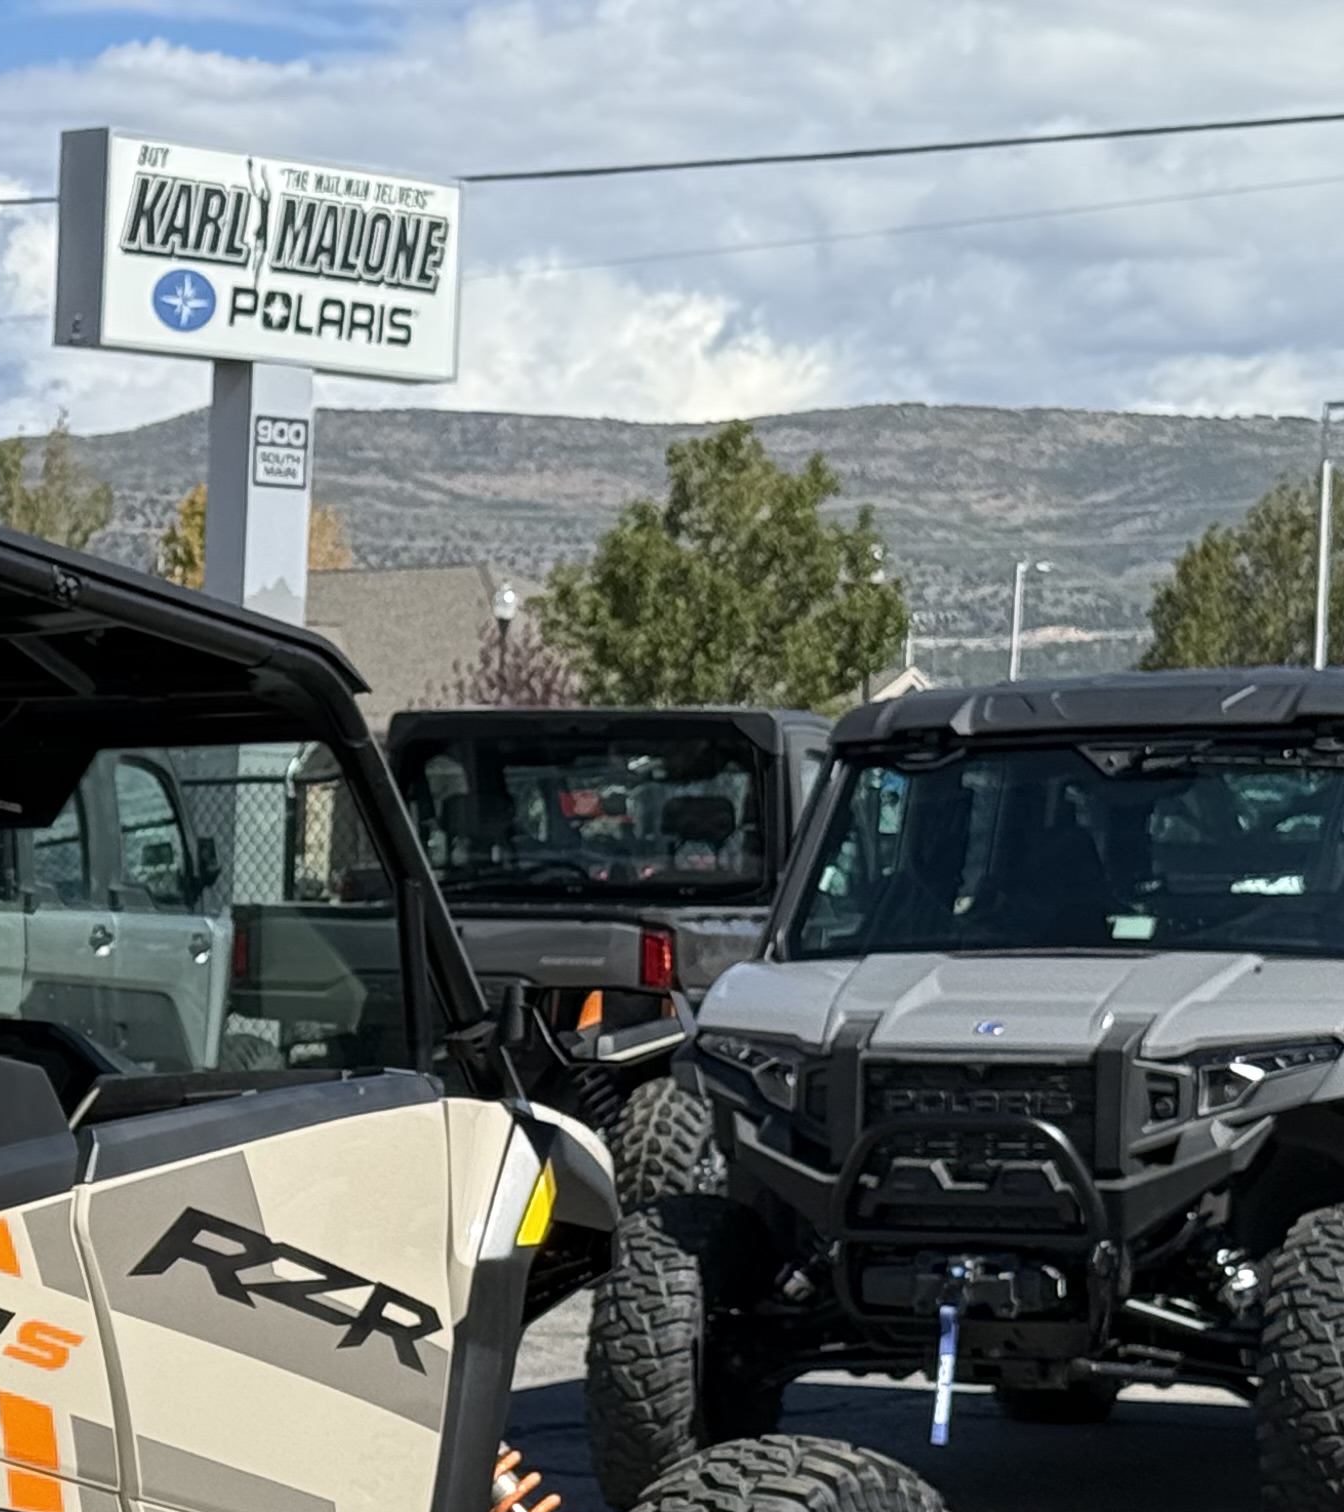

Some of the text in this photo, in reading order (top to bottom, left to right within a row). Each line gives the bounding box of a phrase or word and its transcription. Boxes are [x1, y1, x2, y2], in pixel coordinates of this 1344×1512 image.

[137, 144, 170, 169] BUY
[120, 172, 448, 295] KARL MALONE
[228, 286, 414, 348] POLARIS
[127, 1206, 443, 1377] RZR
